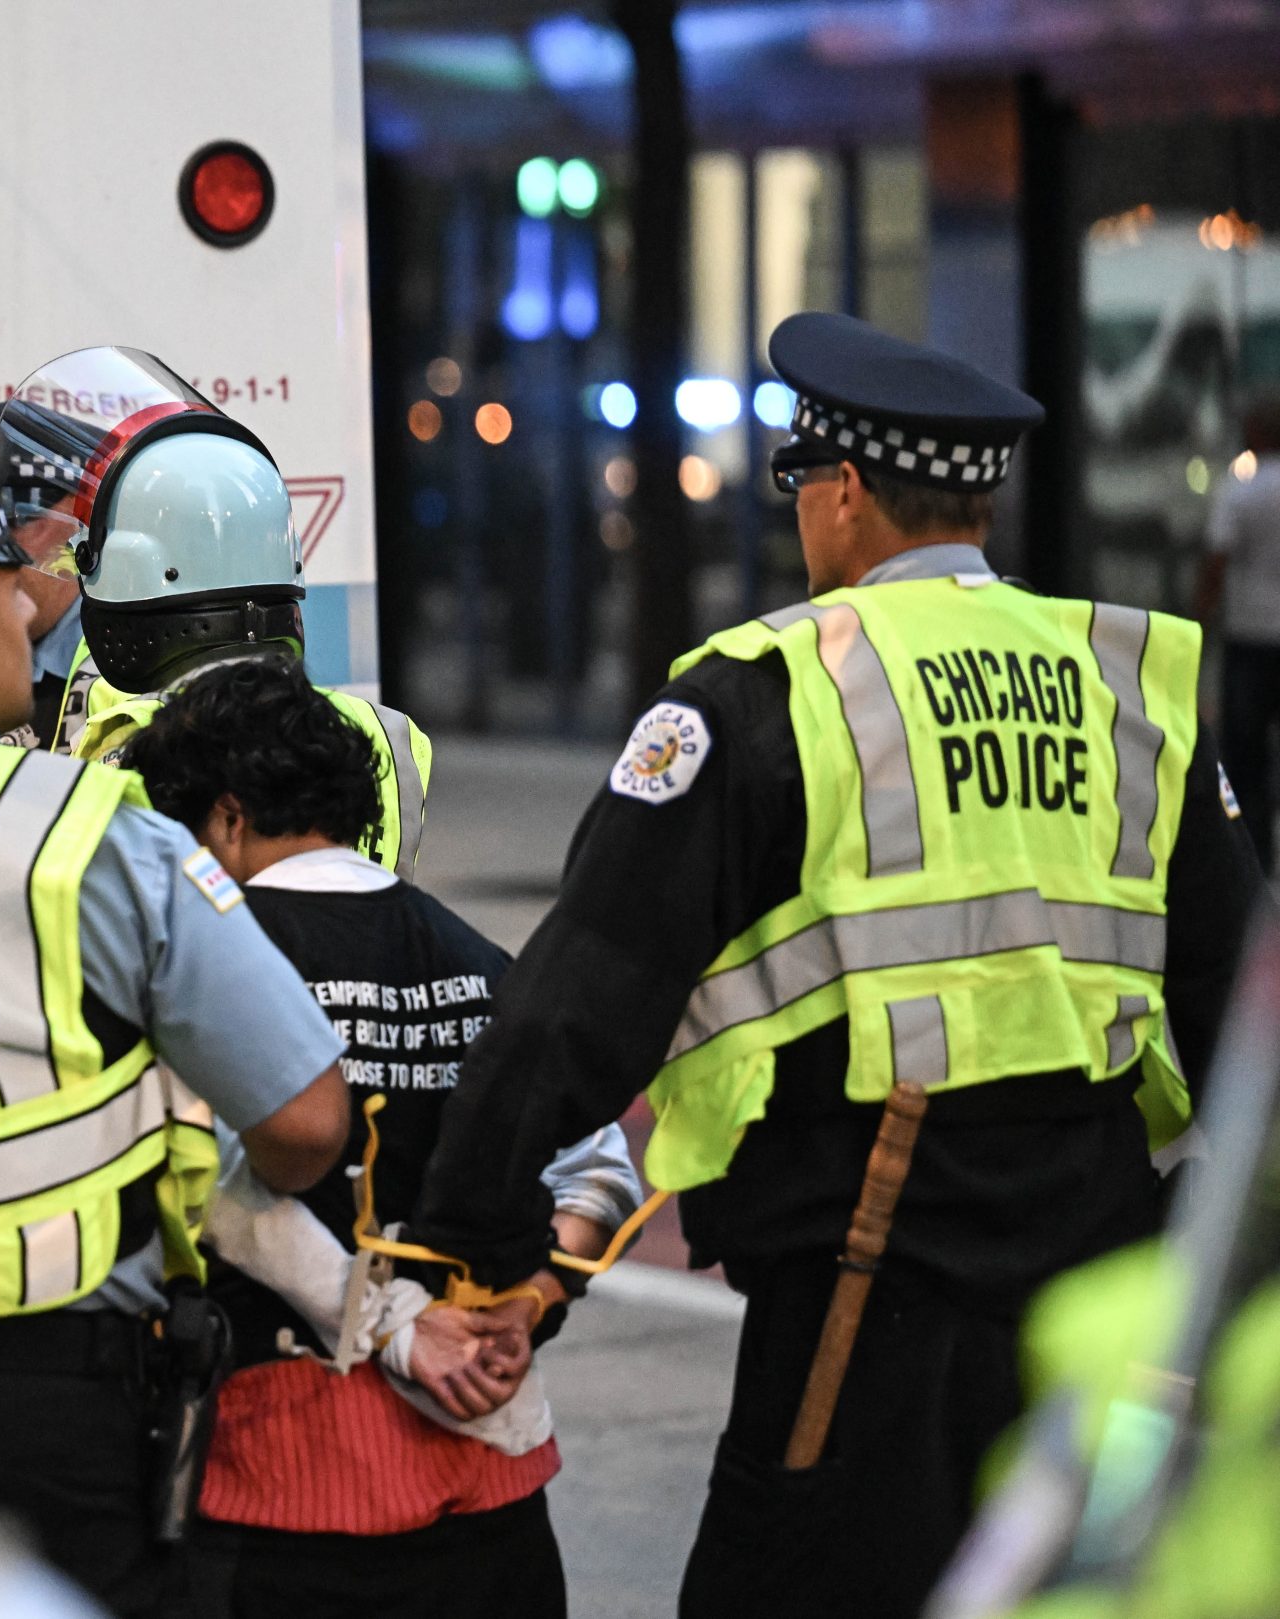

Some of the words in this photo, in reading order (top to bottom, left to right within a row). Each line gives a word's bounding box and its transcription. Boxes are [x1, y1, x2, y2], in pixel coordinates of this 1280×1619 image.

[213, 377, 289, 405] 9-1-1
[916, 648, 1083, 729] CHICAGO
[939, 731, 1088, 815] POICE
[381, 985, 399, 1012] IS
[404, 1023, 427, 1050] OF
[338, 1057, 385, 1088] OOSE
[388, 1063, 409, 1089] TO
